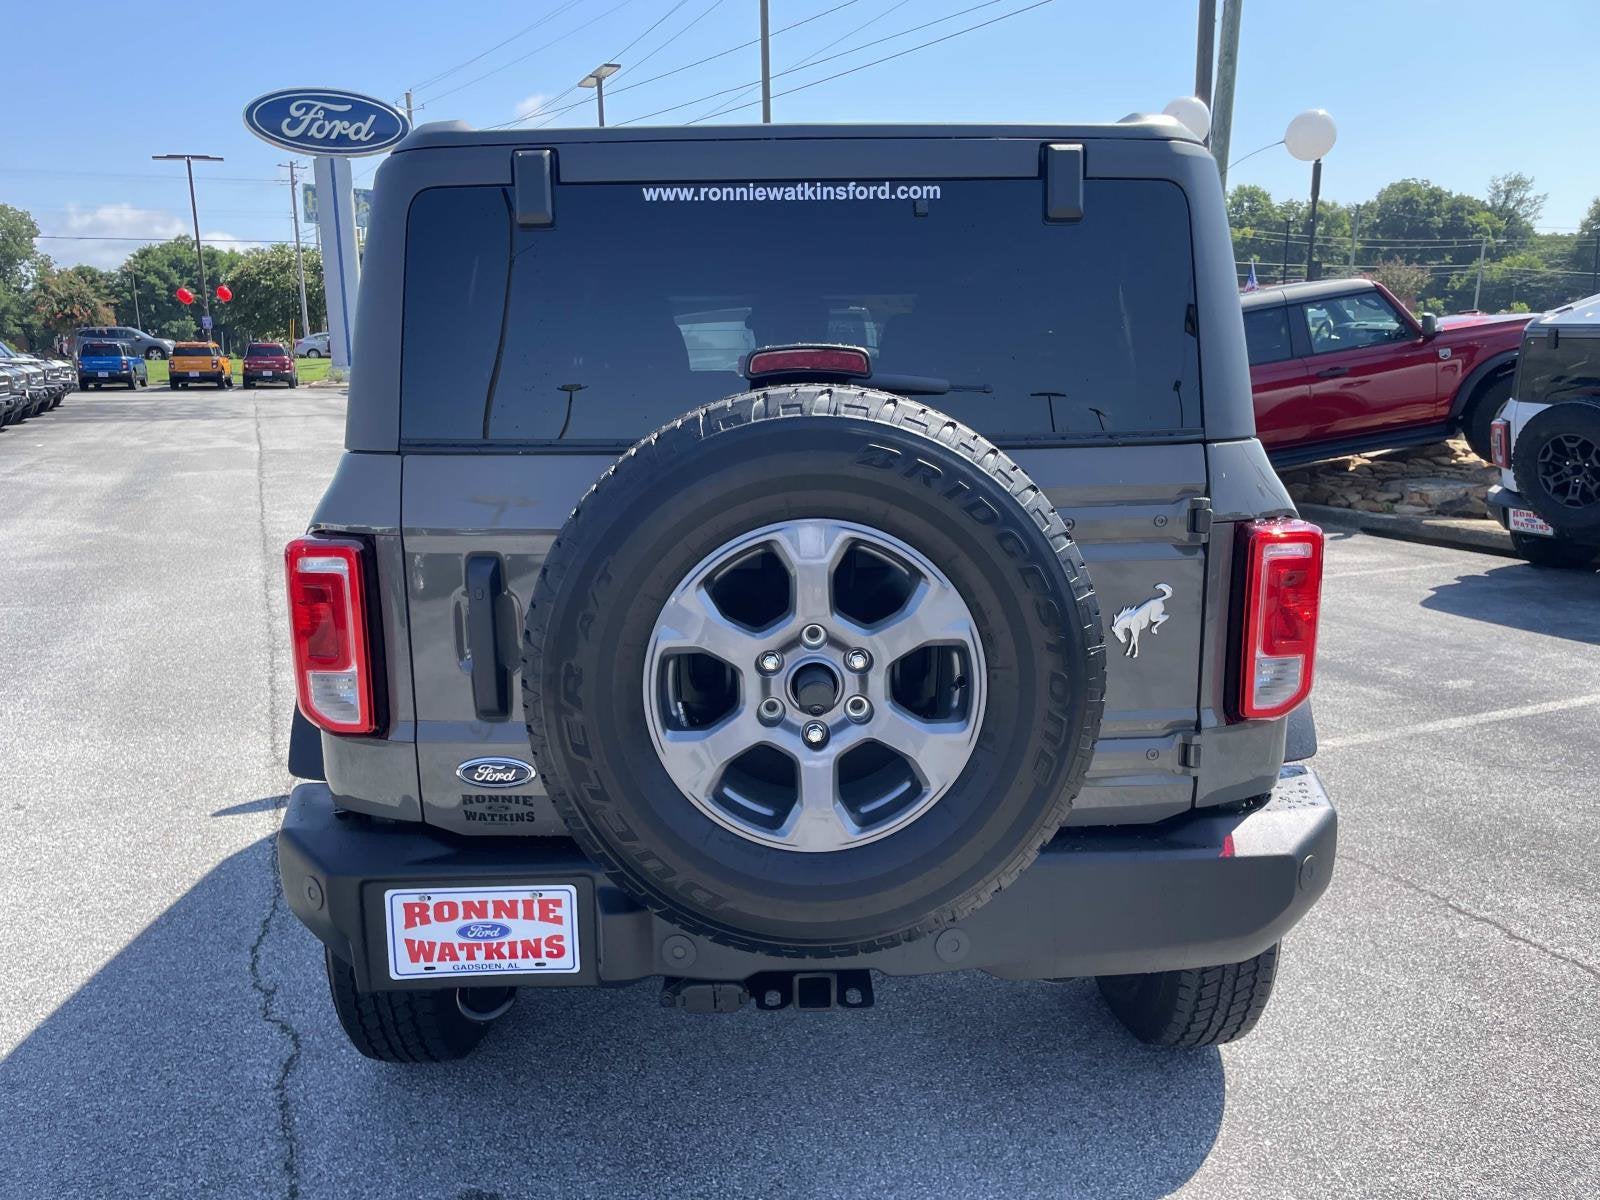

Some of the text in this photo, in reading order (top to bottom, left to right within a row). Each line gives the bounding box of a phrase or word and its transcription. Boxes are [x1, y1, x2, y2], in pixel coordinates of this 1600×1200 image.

[281, 100, 376, 141] Ford
[642, 181, 941, 201] www.ronniewatkinsford.com
[854, 442, 1070, 787] BRIDGESTONE
[474, 764, 516, 782] Ford
[560, 659, 732, 912] DUELER
[462, 794, 534, 807] RONNIE
[464, 810, 536, 823] WATKINS
[403, 898, 564, 930] RONNIE
[467, 923, 501, 938] Ford
[404, 934, 566, 964] WATKINS
[452, 963, 505, 971] GADSDEN,
